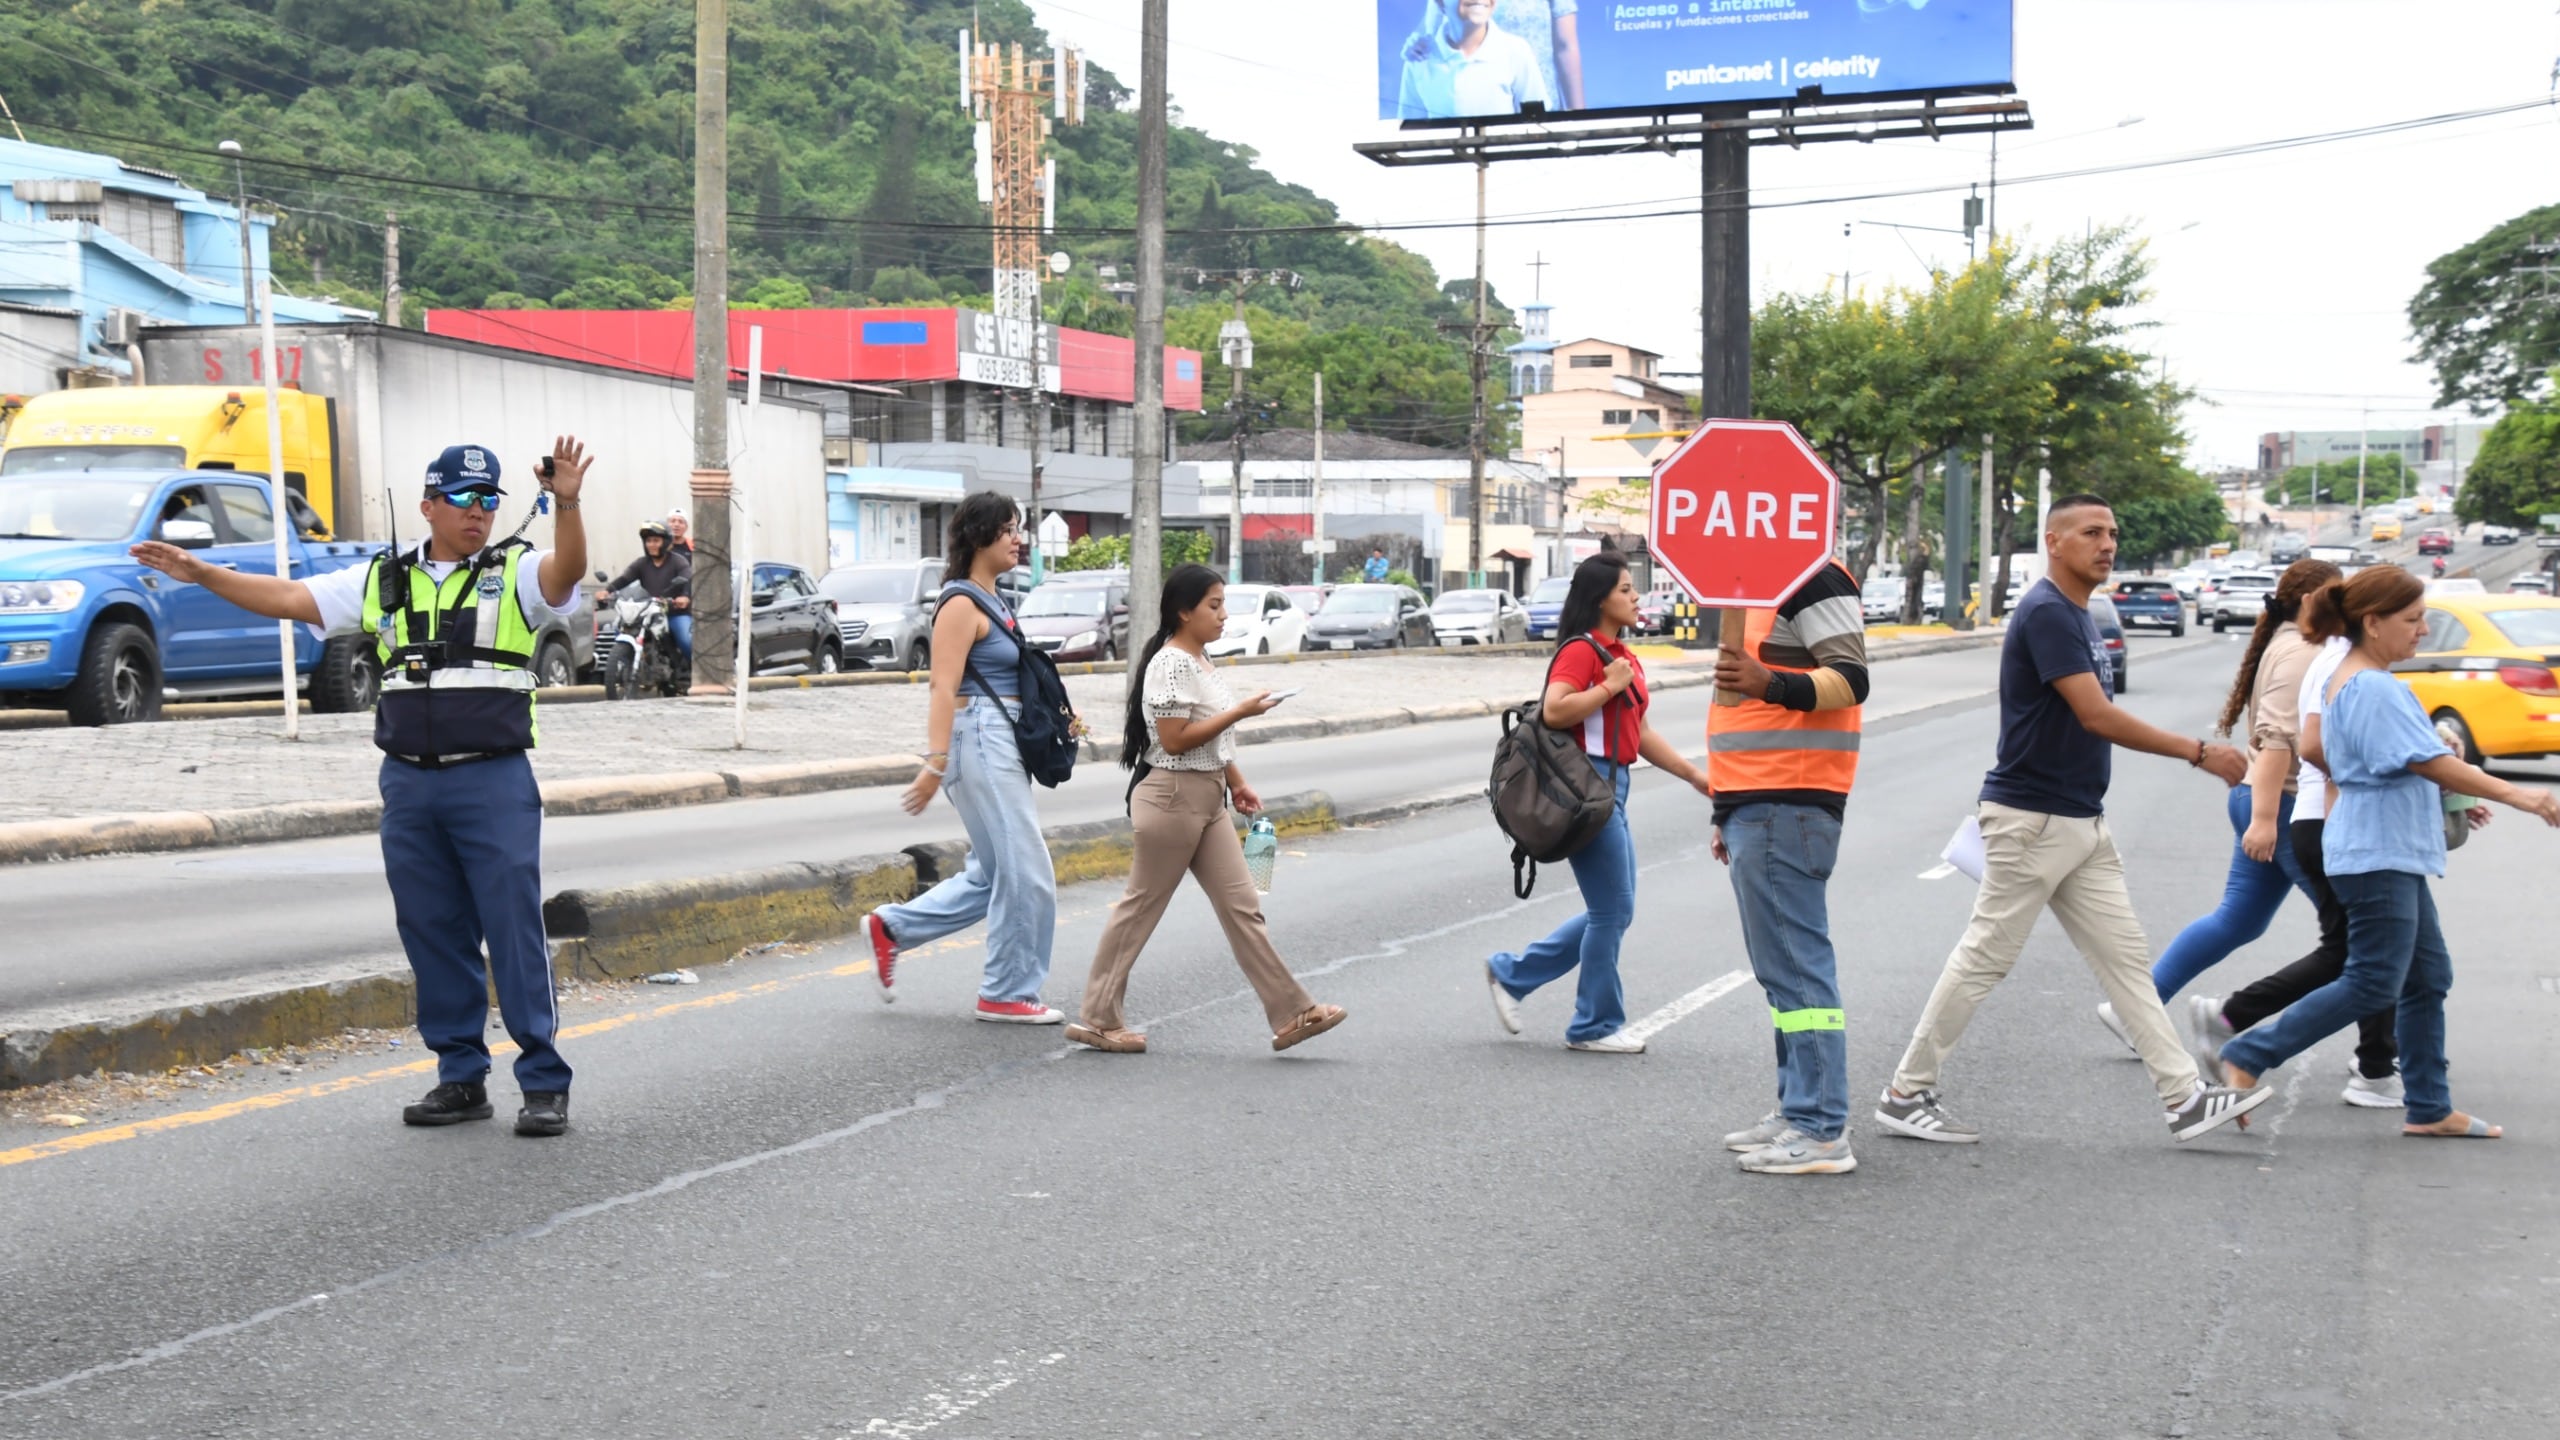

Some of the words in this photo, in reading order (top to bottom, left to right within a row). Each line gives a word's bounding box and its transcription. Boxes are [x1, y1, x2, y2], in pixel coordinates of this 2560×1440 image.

[1614, 3, 1679, 19] Acceso
[1688, 2, 1699, 14] a
[1709, 0, 1796, 13] internet
[1614, 19, 1663, 32] Escuelas
[1665, 19, 1672, 30] y
[1675, 14, 1743, 28] fundaciones
[1745, 9, 1809, 23] conectadas
[1666, 60, 1774, 91] puntonet
[1793, 54, 1880, 79] celerity
[974, 312, 996, 355] SE
[996, 316, 1048, 362] VENE
[203, 346, 224, 382] S
[1666, 488, 1819, 541] PARE
